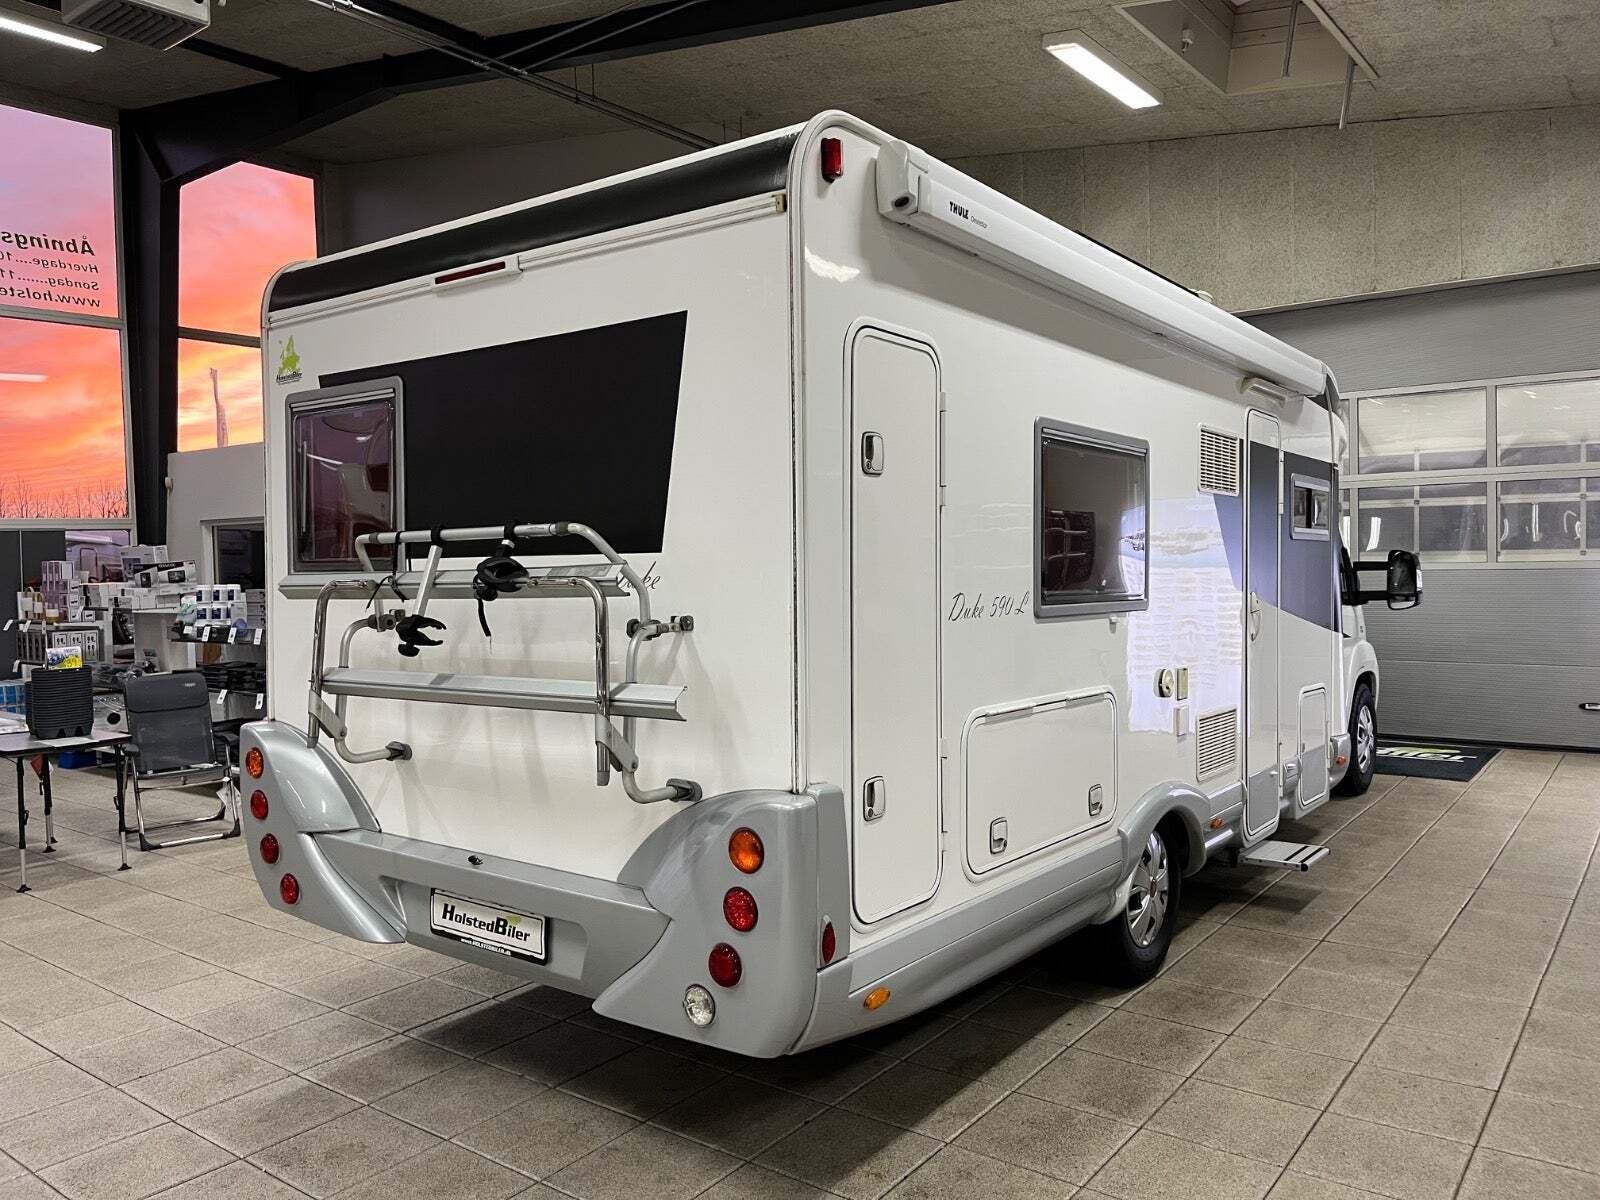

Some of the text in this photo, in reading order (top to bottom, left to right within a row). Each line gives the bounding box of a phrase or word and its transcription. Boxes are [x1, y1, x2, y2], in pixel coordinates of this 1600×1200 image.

[949, 201, 969, 220] THULE
[947, 590, 1030, 622] Duke 590 L
[441, 903, 531, 942] HolstedBiler
